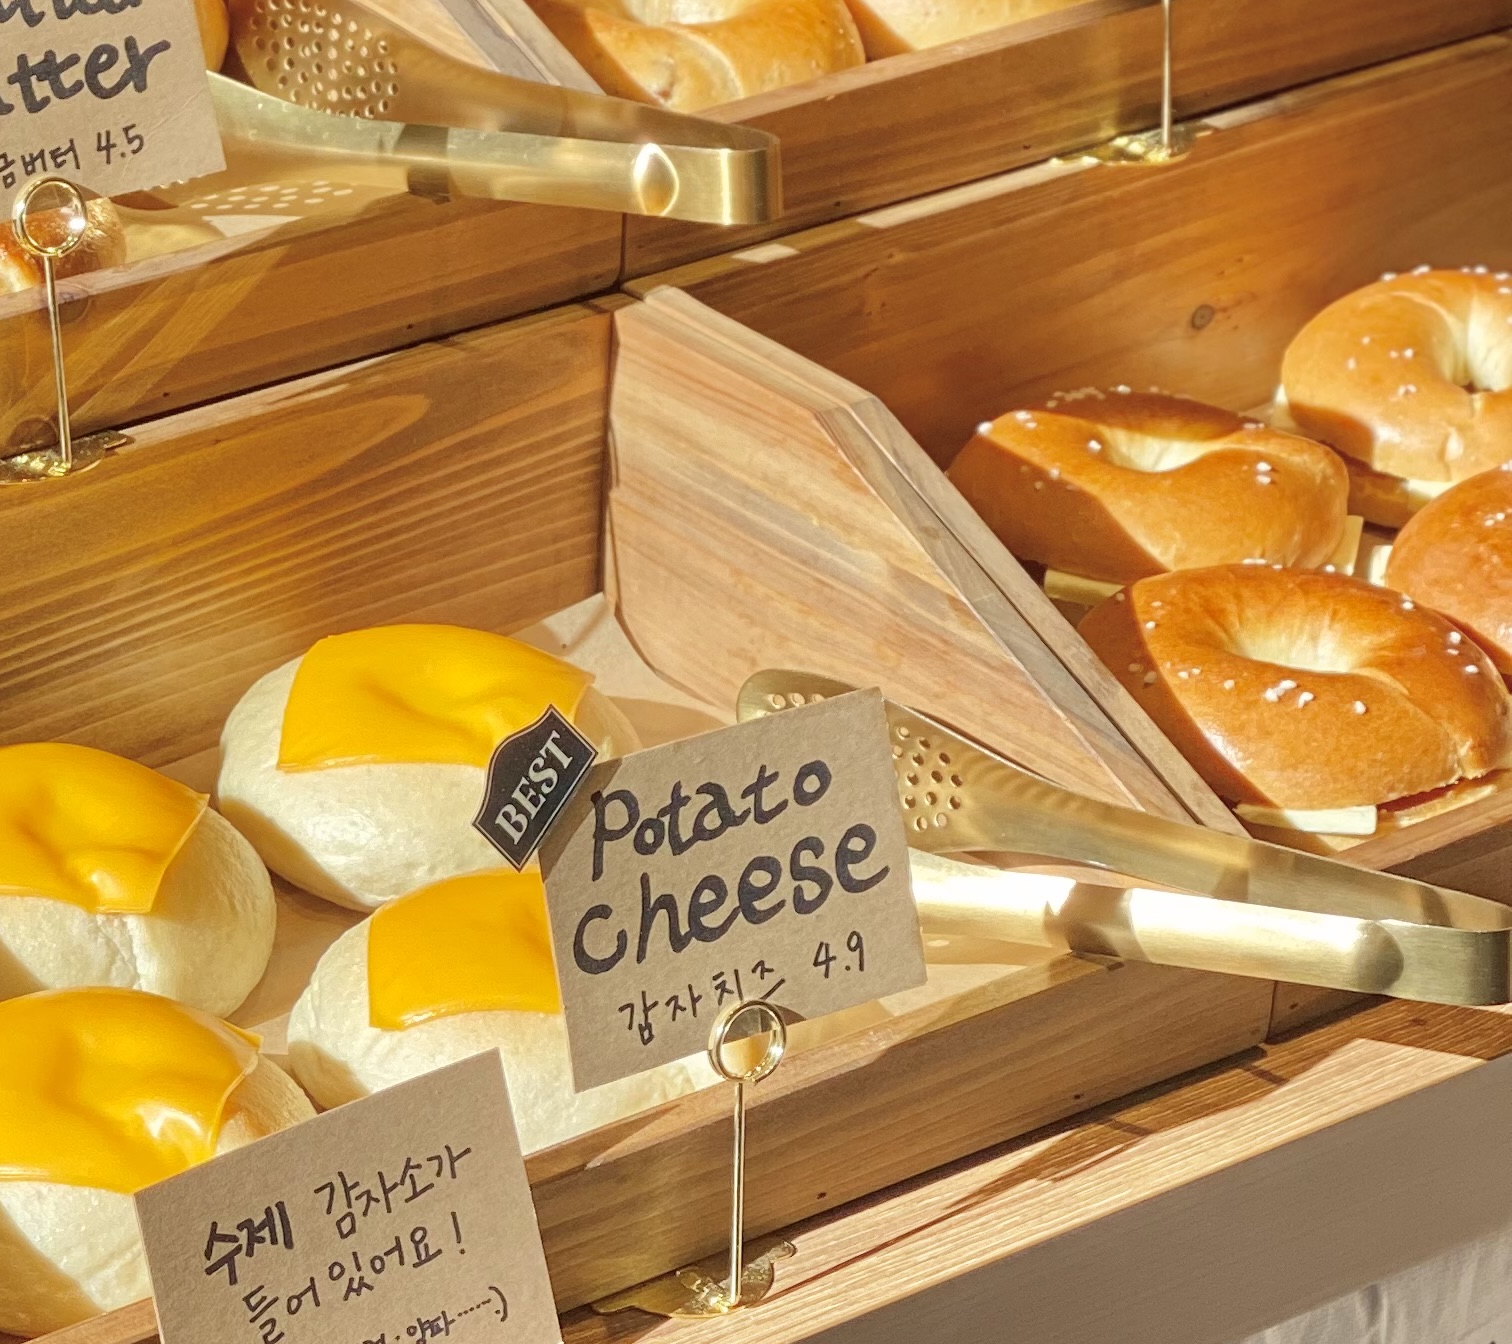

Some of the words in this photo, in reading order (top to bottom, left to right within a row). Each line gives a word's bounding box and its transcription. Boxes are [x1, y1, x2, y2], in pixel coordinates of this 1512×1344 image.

[95, 123, 146, 166] 4.5
[494, 730, 574, 845] BEST
[813, 931, 865, 979] 4.9
[203, 1200, 294, 1286] 수제
[313, 1144, 472, 1239] 감자소가
